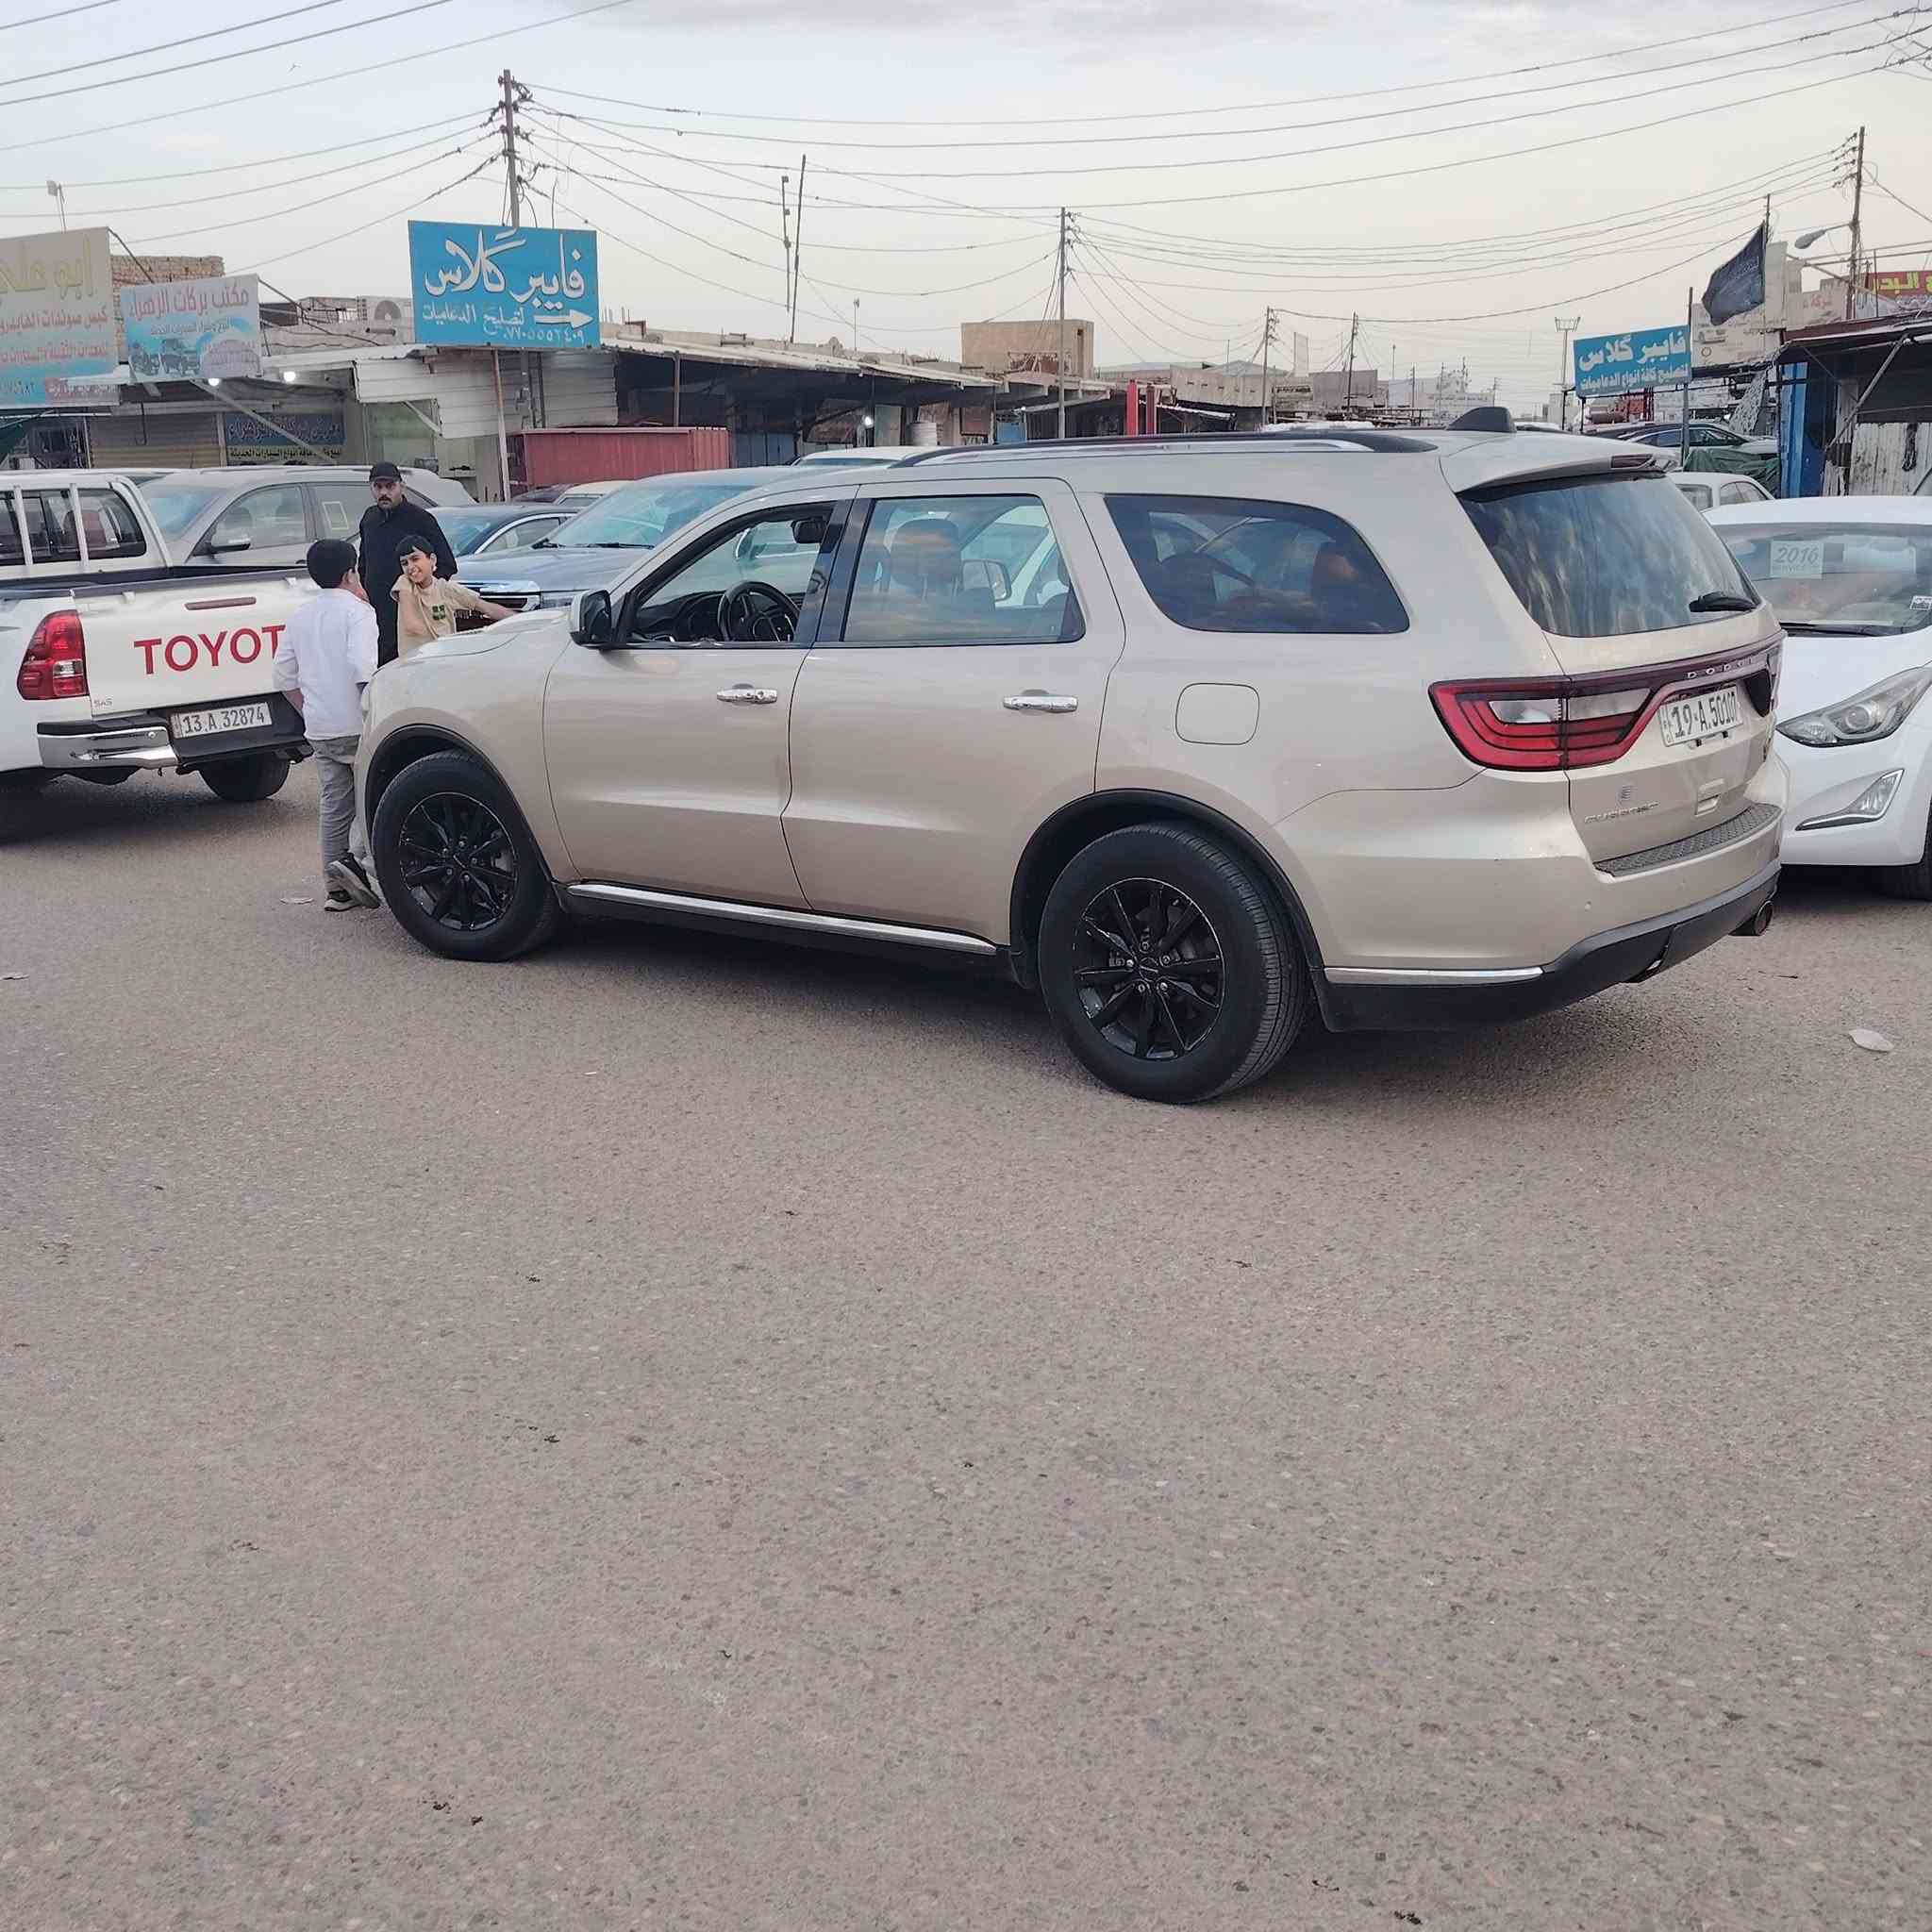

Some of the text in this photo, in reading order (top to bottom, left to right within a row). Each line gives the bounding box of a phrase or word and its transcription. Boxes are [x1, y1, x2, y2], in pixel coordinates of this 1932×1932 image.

[508, 233, 585, 310] فايبر
[173, 284, 208, 316] بركات
[211, 282, 250, 309] مكتب
[1637, 330, 1687, 363] فايبر
[1774, 547, 1820, 565] 2016
[134, 625, 286, 675] TOYOT
